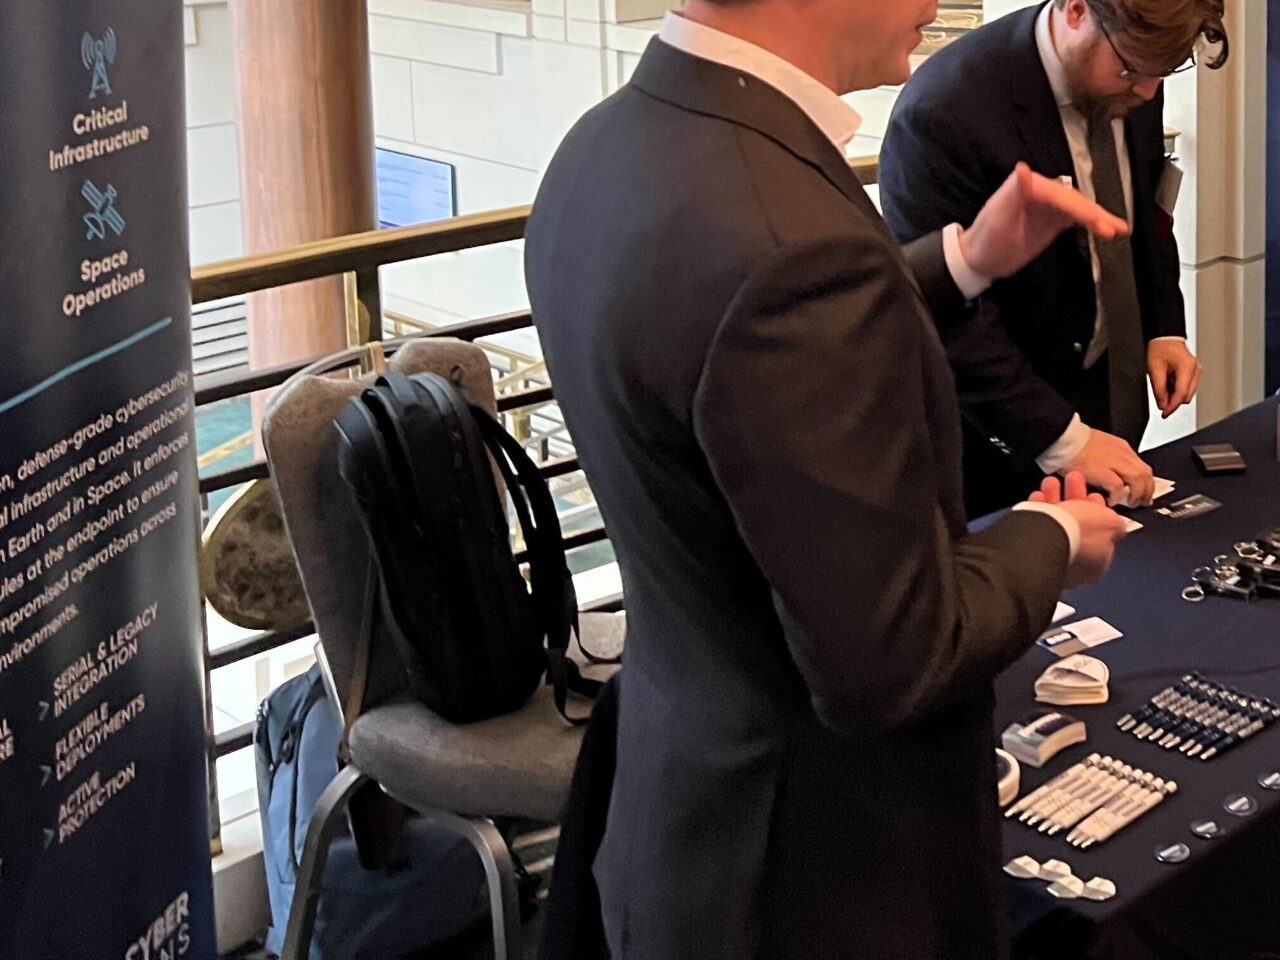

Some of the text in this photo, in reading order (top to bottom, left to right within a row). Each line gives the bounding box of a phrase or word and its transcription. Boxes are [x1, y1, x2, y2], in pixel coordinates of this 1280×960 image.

[49, 125, 149, 171] Infrastructure
[73, 100, 128, 135] Critical
[62, 268, 146, 317] Operations
[80, 250, 129, 283] Space
[11, 457, 96, 520] infrastructure
[98, 436, 124, 465] and
[126, 397, 190, 448] operational
[17, 413, 114, 481] defense-grade
[115, 371, 189, 423] cybersecurity
[8, 522, 45, 558] Earth
[46, 501, 71, 532] and
[72, 496, 85, 515] in
[133, 461, 142, 478] It
[26, 559, 42, 580] at
[44, 545, 65, 568] the
[66, 504, 124, 552] endpoint
[126, 496, 140, 513] to
[141, 471, 179, 504] ensure
[70, 528, 139, 583] operations
[53, 601, 158, 696] SERIAL & LEGACY
[54, 637, 138, 717] INTEGRATION
[56, 702, 108, 760] FLEXIBLE
[57, 693, 145, 781] DEPLOYMENTS
[58, 771, 100, 822] ACTIVE
[59, 761, 136, 843] PROTECTION
